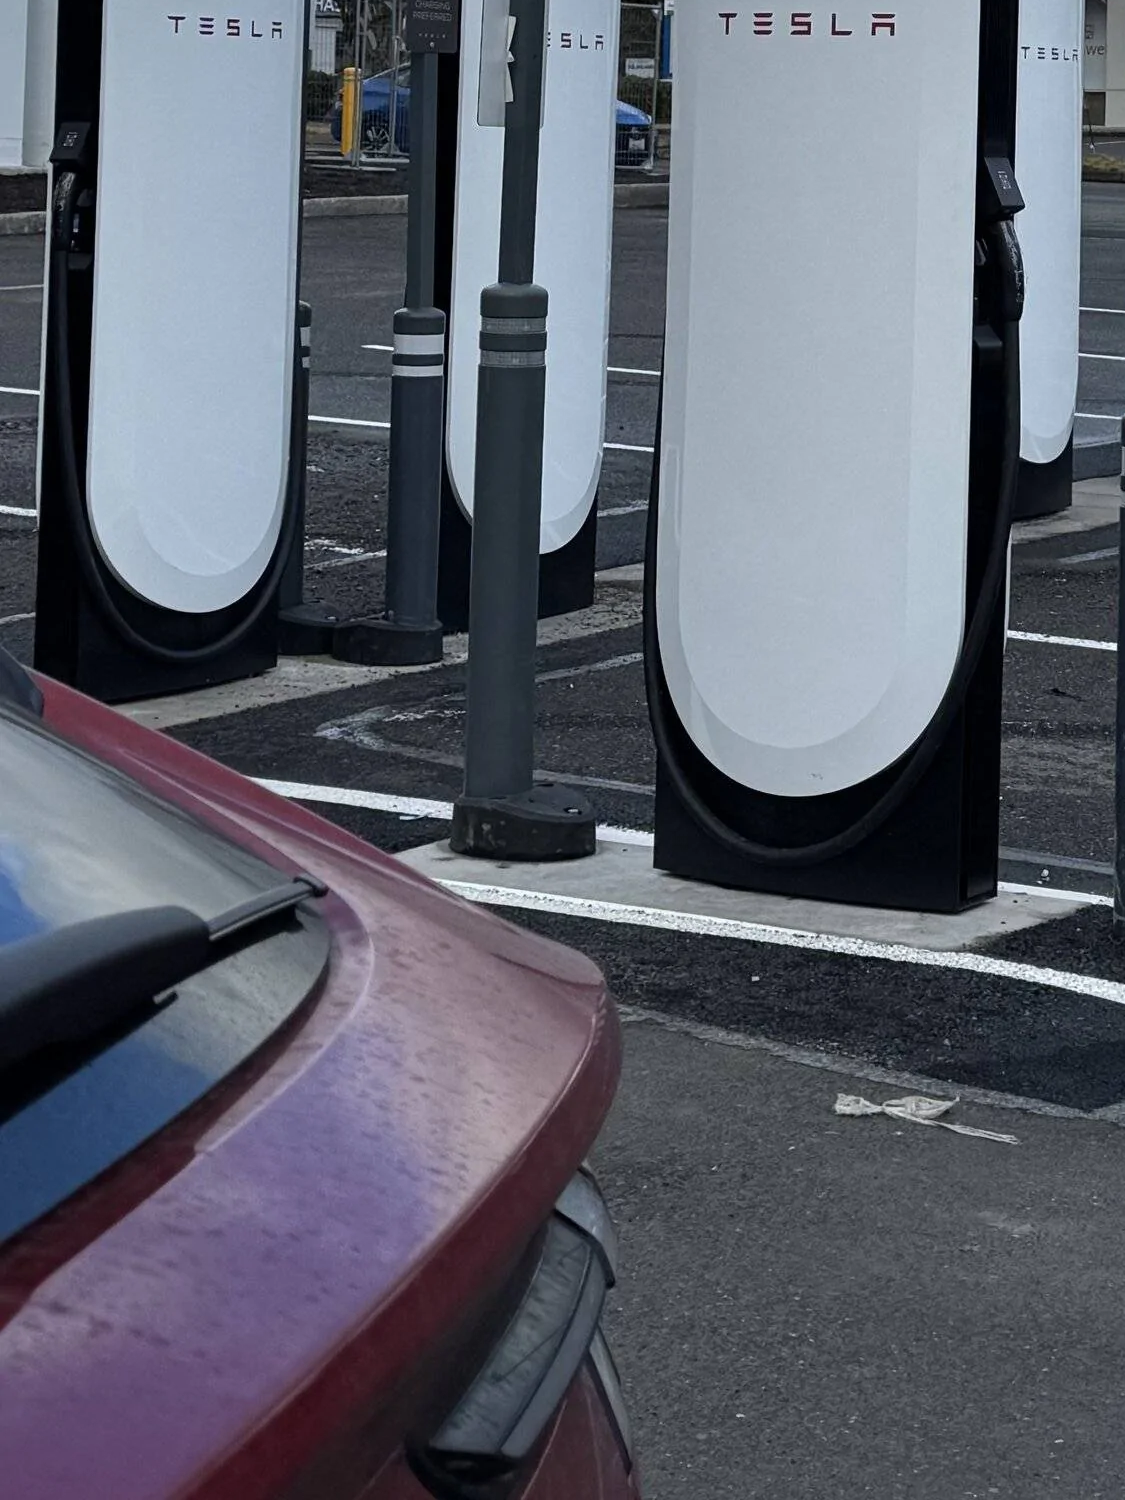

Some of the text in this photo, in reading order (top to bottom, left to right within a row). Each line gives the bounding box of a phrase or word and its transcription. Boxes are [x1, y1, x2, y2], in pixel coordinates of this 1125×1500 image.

[413, 11, 452, 22] PREFERRED
[718, 12, 896, 36] TESLA
[167, 15, 282, 39] TESLA
[1021, 46, 1078, 62] TESLA
